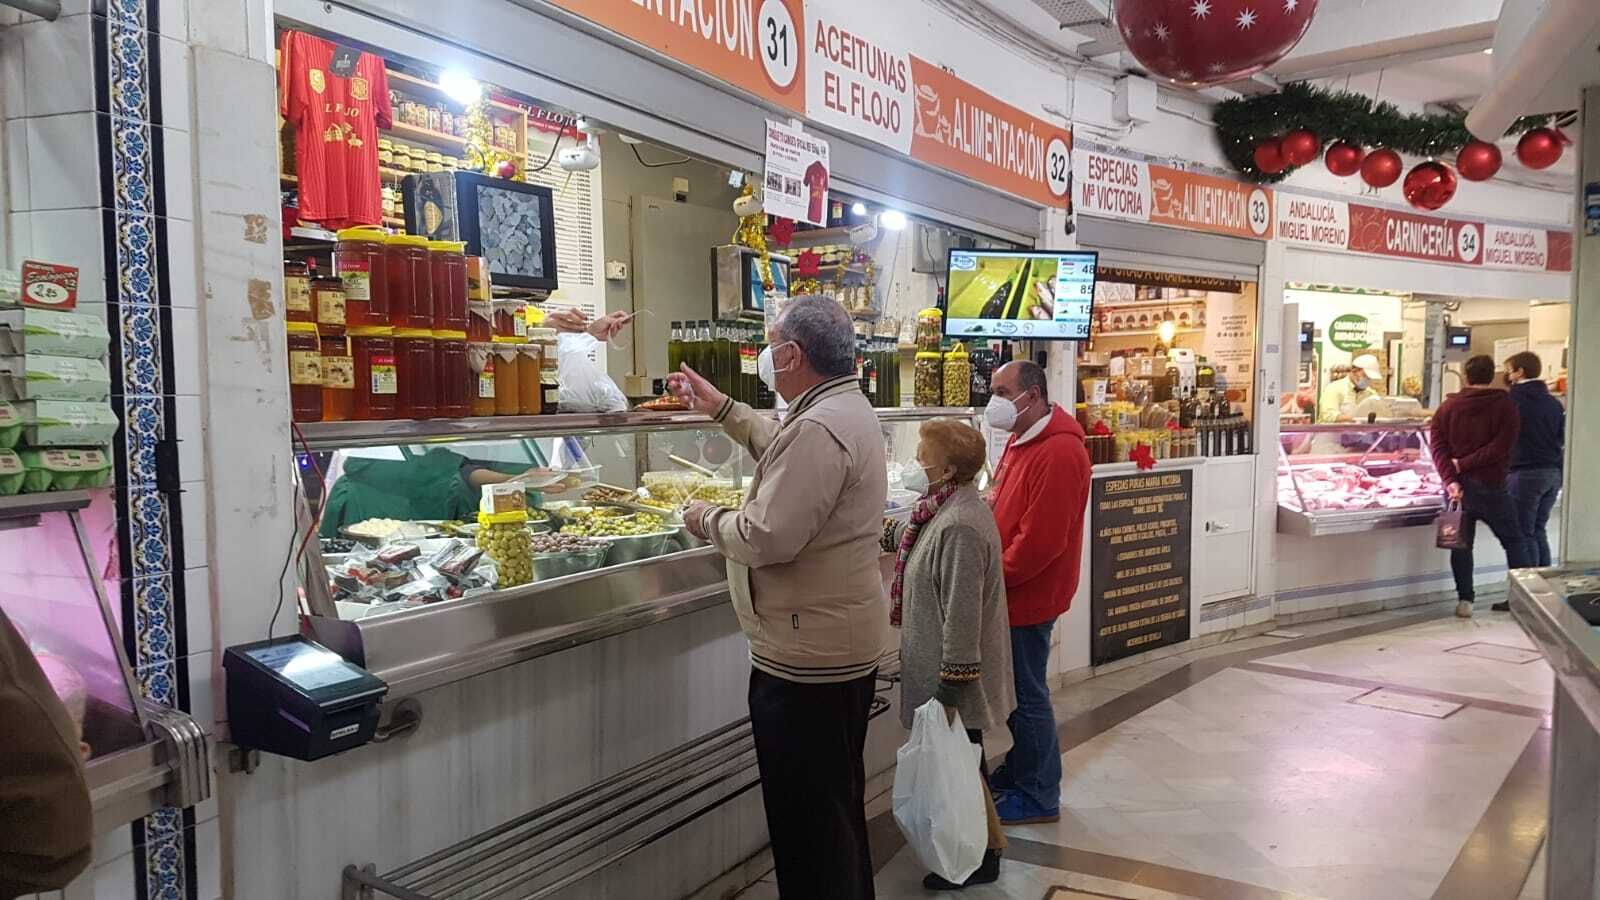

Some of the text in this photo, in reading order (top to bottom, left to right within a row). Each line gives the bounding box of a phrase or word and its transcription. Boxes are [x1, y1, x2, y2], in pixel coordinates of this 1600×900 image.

[766, 16, 788, 67] 31
[815, 20, 907, 93] ACEITUNAS
[824, 72, 900, 133] EL FLOJO
[953, 98, 1045, 183] ALIMENTACIÓN
[1051, 152, 1066, 182] 32
[1088, 155, 1138, 187] ESPECIAS
[1082, 183, 1143, 216] Mª VICTORIA
[1182, 183, 1247, 229] ALIMENTACIÓN
[1253, 200, 1265, 224] 33
[1279, 220, 1345, 245] MIGUEL MORENO
[1386, 218, 1454, 257] CARNICERÍA
[1462, 234, 1475, 253] 34
[1082, 264, 1094, 274] 48
[1486, 247, 1545, 266] MIGUEL MORENO
